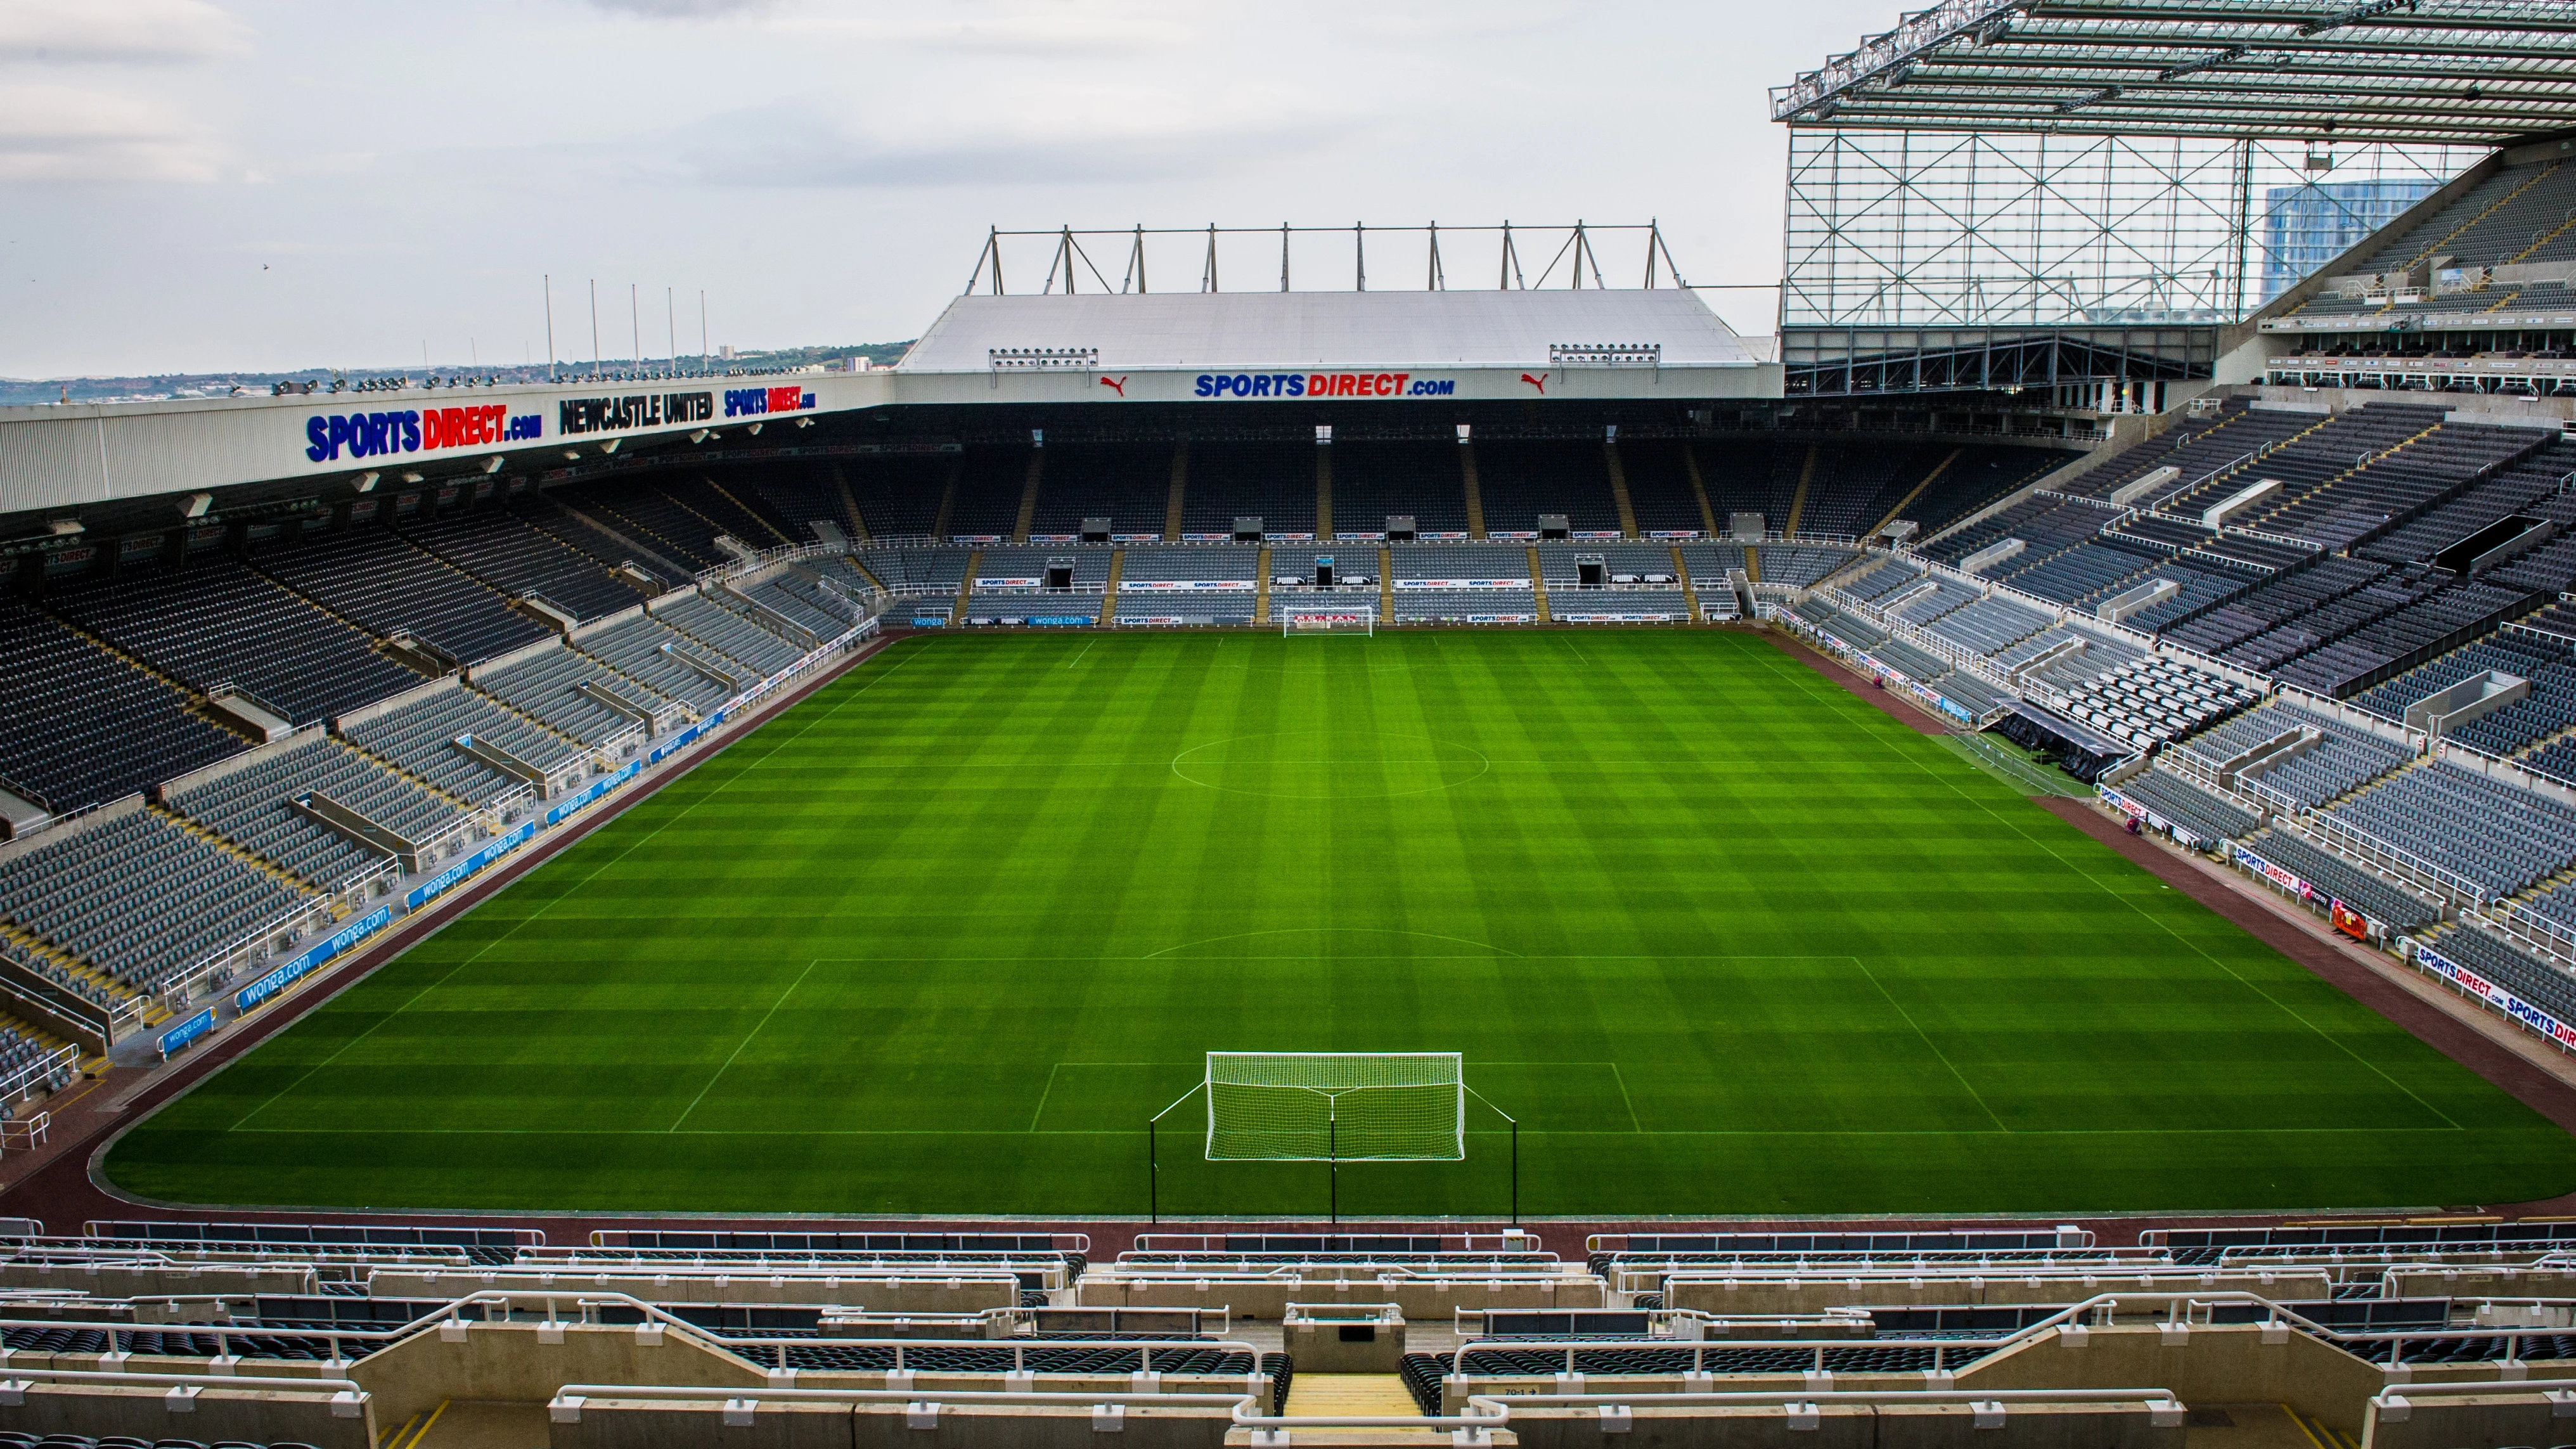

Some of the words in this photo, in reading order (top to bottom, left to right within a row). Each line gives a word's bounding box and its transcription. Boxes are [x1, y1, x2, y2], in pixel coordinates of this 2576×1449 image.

[1195, 374, 1454, 396] SPORTSDIRECT.COM
[560, 394, 661, 435] NEWCASTLE
[664, 391, 714, 424] UNITED
[1035, 617, 1083, 625] wonga.com
[558, 790, 592, 816] wonga.com
[484, 829, 524, 860] wonga.com
[423, 861, 469, 898] wonga.com
[332, 908, 386, 951] wonga.com
[247, 955, 310, 1003] wonga.com
[169, 1015, 207, 1042] wonga.com
